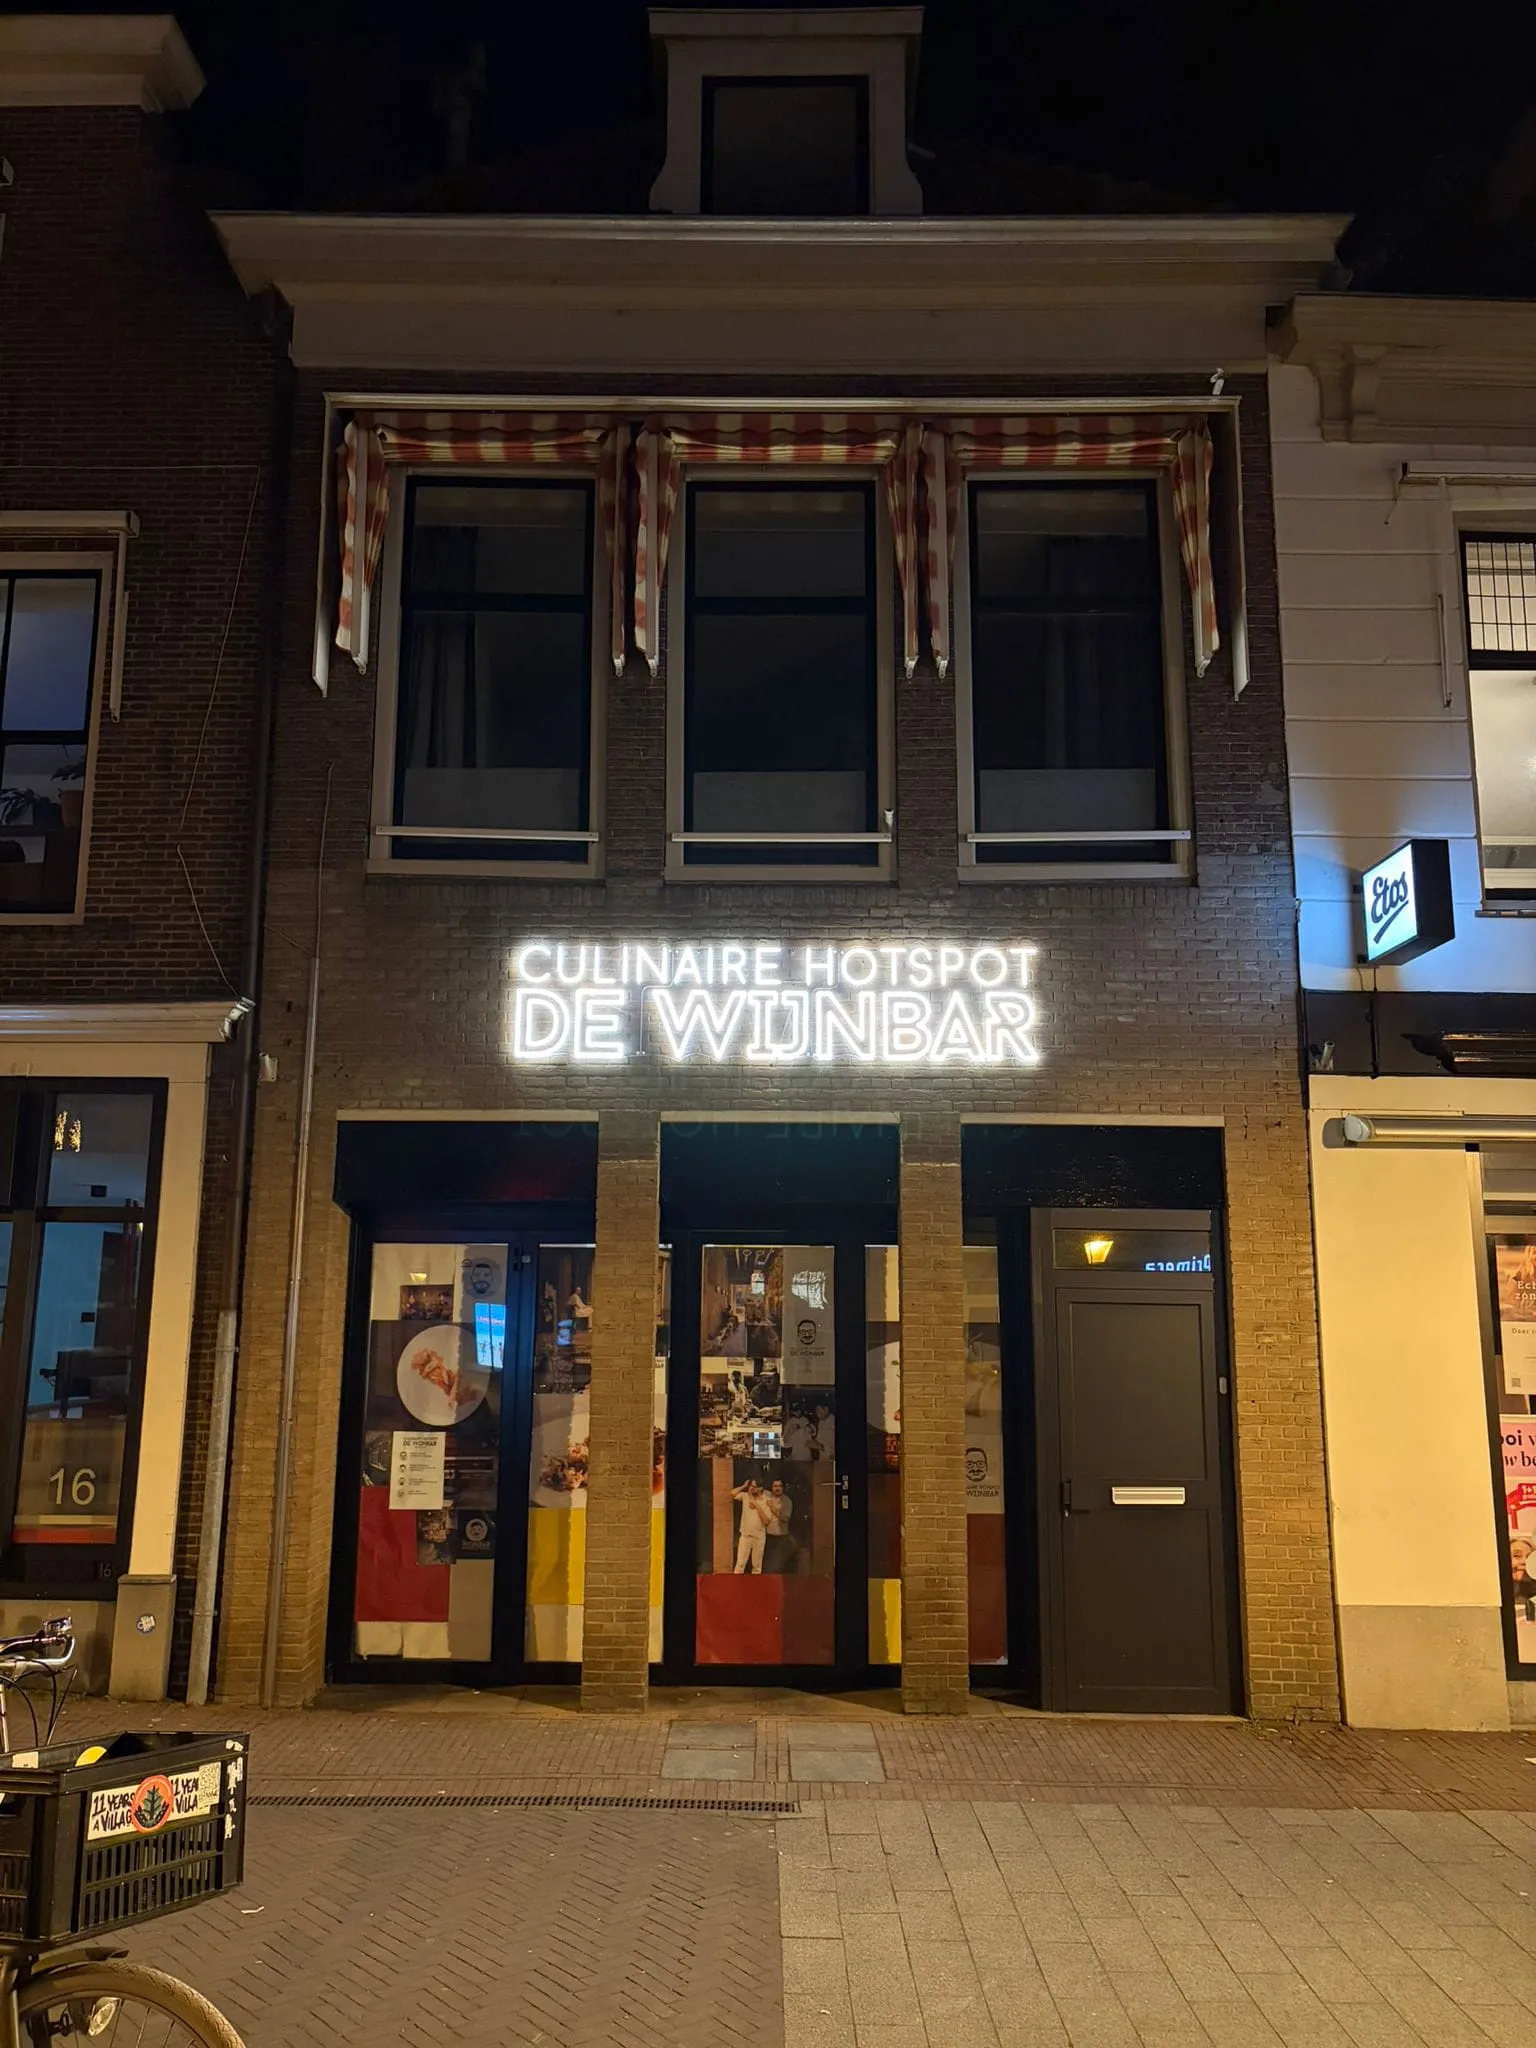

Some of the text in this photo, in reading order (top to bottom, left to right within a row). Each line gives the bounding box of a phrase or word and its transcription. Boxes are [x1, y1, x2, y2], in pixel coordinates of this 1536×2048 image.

[1371, 871, 1408, 924] Etos
[517, 943, 1038, 988] CULINAIRE HOTSPOT
[513, 987, 627, 1060] DE
[49, 1468, 96, 1505] 16
[99, 1562, 112, 1578] 16
